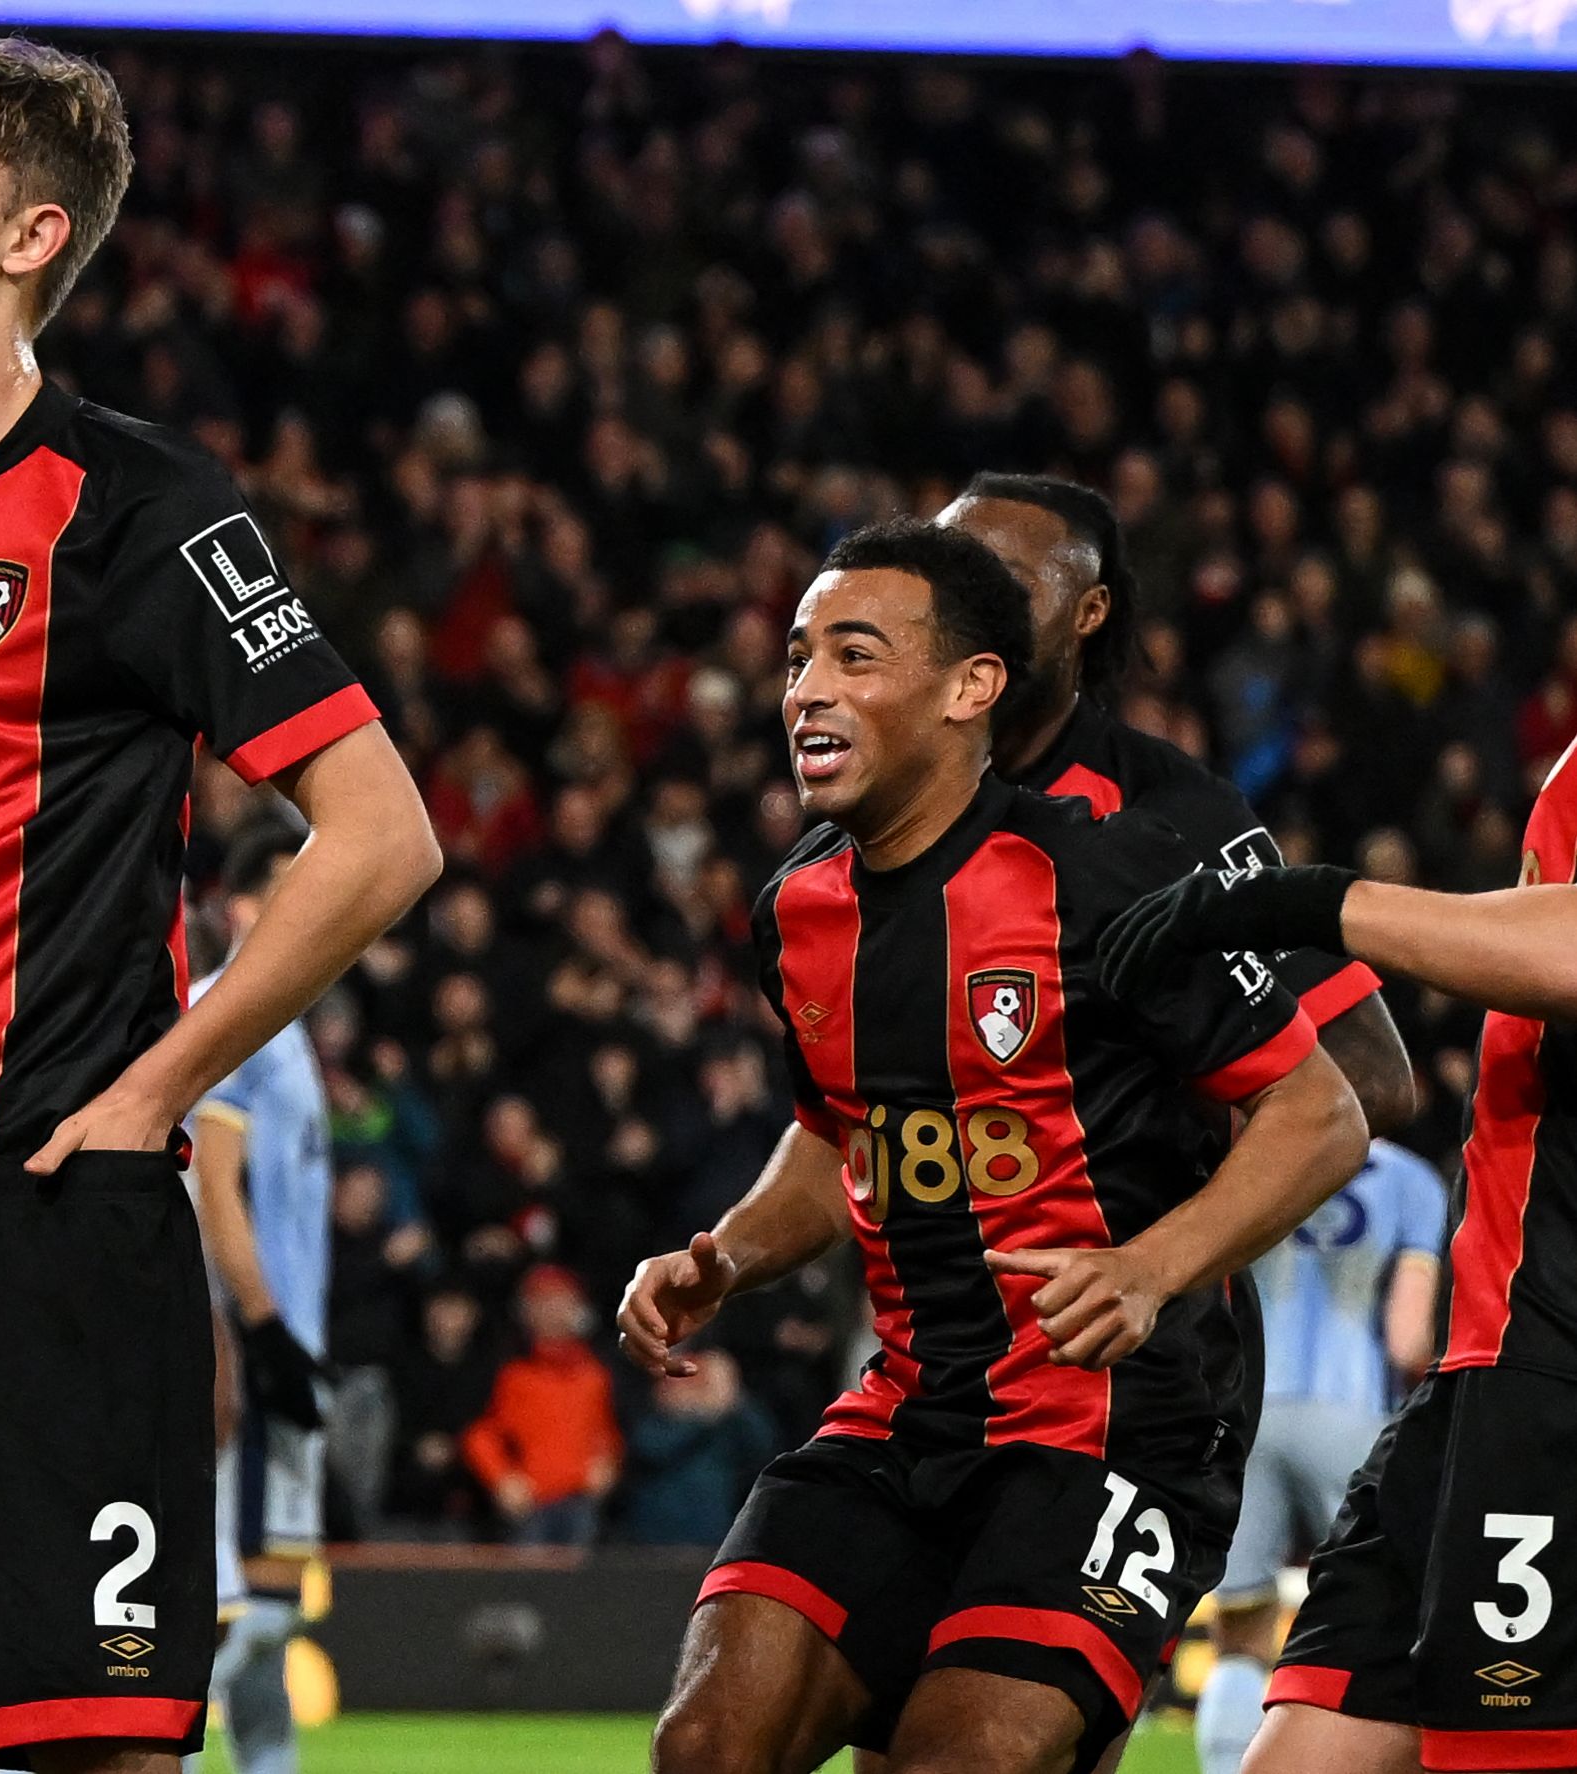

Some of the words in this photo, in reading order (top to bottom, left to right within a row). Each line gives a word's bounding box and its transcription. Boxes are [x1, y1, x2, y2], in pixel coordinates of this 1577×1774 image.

[230, 598, 313, 664] LEOS
[90, 1501, 156, 1629] 2
[1080, 1471, 1175, 1620] 12
[1473, 1513, 1554, 1643] 3
[106, 1664, 151, 1678] umbro
[1480, 1692, 1532, 1707] umbro
